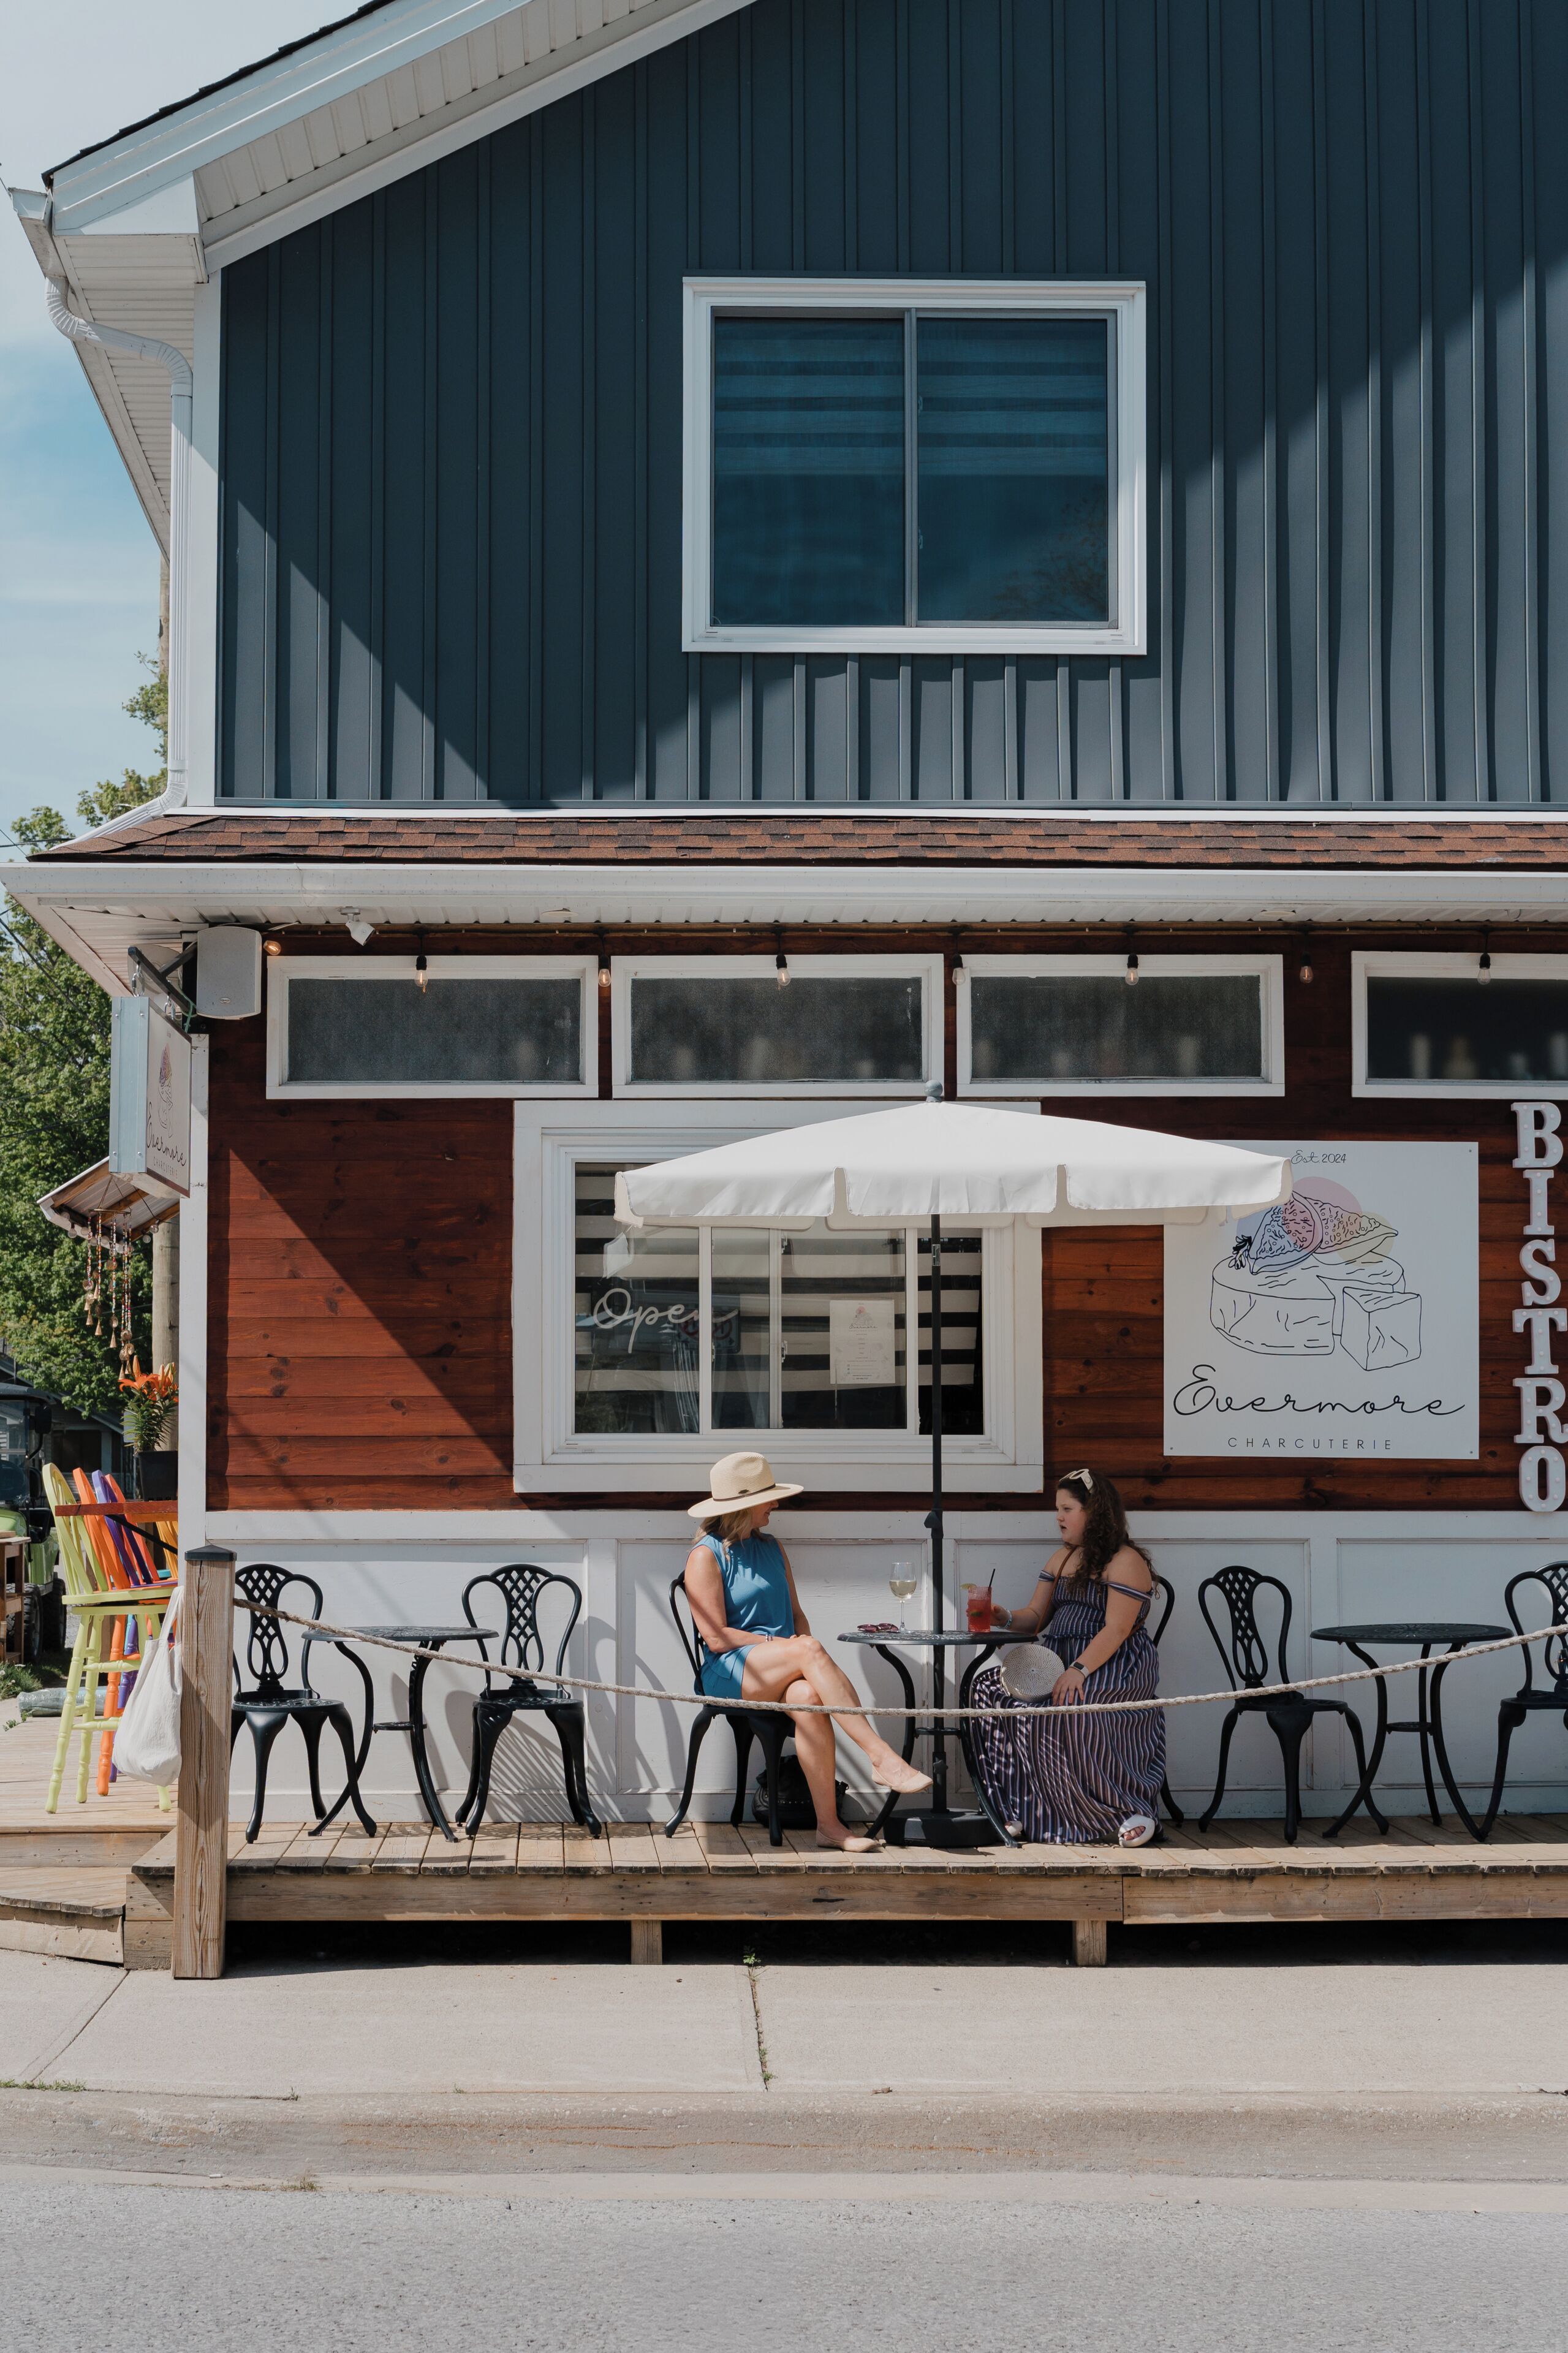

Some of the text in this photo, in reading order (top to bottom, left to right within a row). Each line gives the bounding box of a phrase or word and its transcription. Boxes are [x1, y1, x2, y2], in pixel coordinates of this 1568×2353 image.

[147, 1101, 187, 1167] Evermore
[1290, 1150, 1347, 1165] Est. 2024
[1510, 1102, 1568, 1512] BISTRO
[1173, 1364, 1466, 1415] Evermore
[1227, 1437, 1392, 1450] CHARCUTERIE
